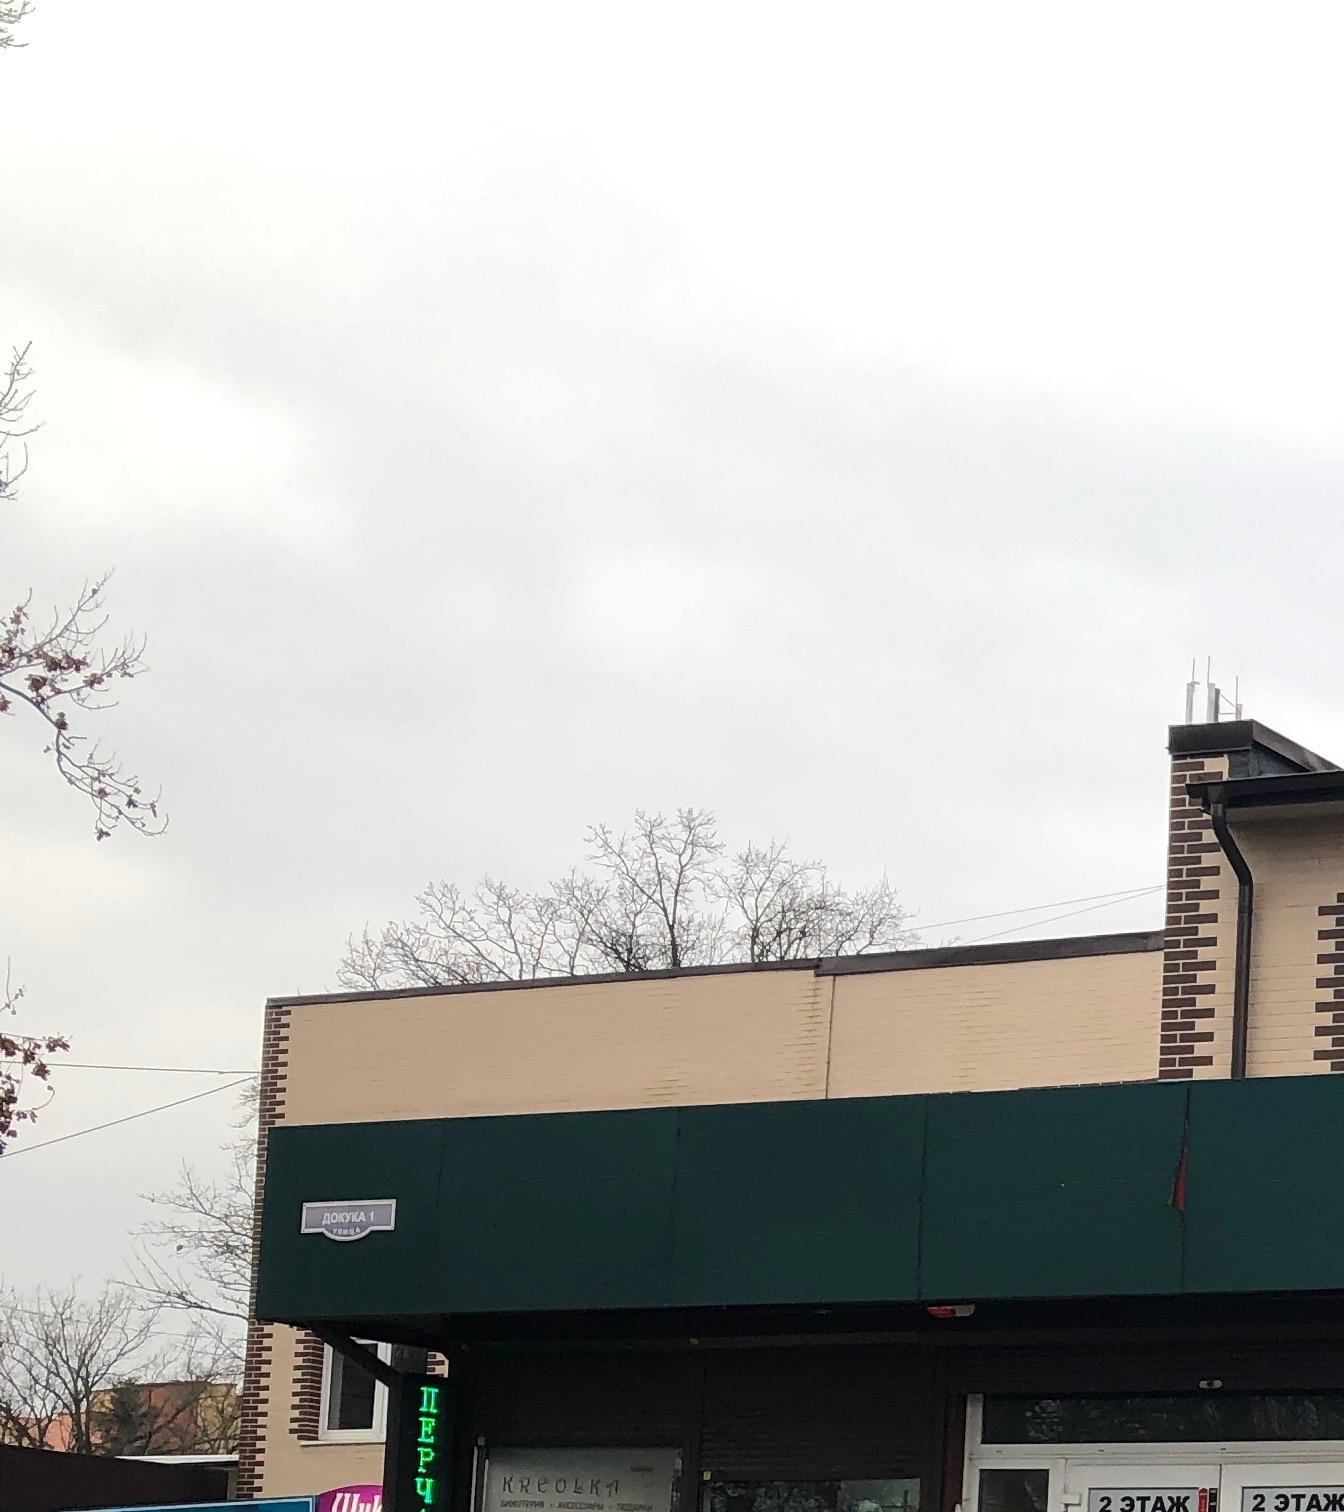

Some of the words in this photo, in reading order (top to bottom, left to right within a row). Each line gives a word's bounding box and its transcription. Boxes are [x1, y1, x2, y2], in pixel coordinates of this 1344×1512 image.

[321, 1211, 366, 1226] ДОКУКА
[369, 1210, 375, 1222] 1
[1252, 1493, 1266, 1512] 2
